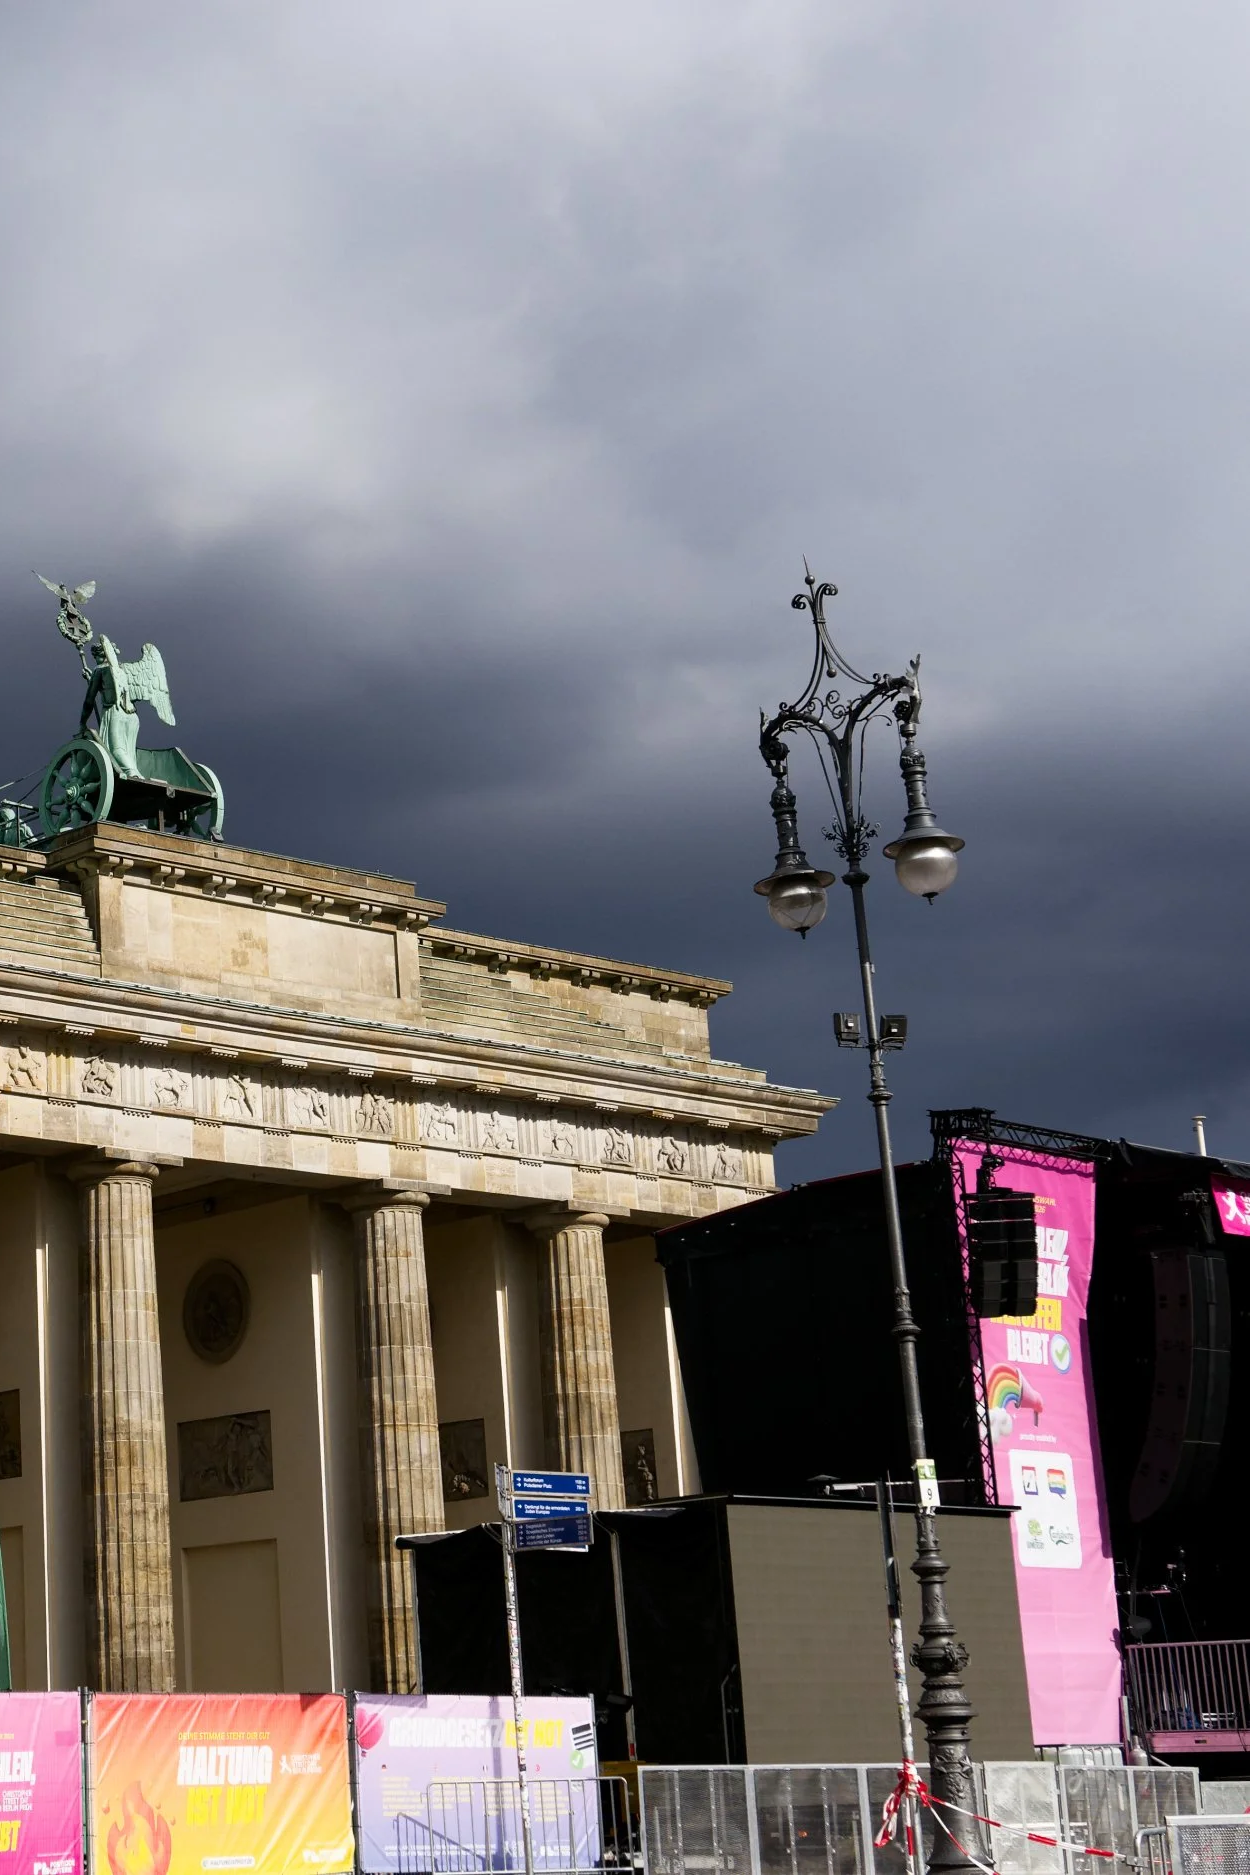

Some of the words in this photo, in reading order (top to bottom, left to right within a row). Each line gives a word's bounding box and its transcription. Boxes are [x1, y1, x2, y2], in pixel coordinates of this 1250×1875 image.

[177, 1744, 273, 1786] HALTUNG
[185, 1786, 223, 1827] IST
[224, 1785, 267, 1826] HOT
